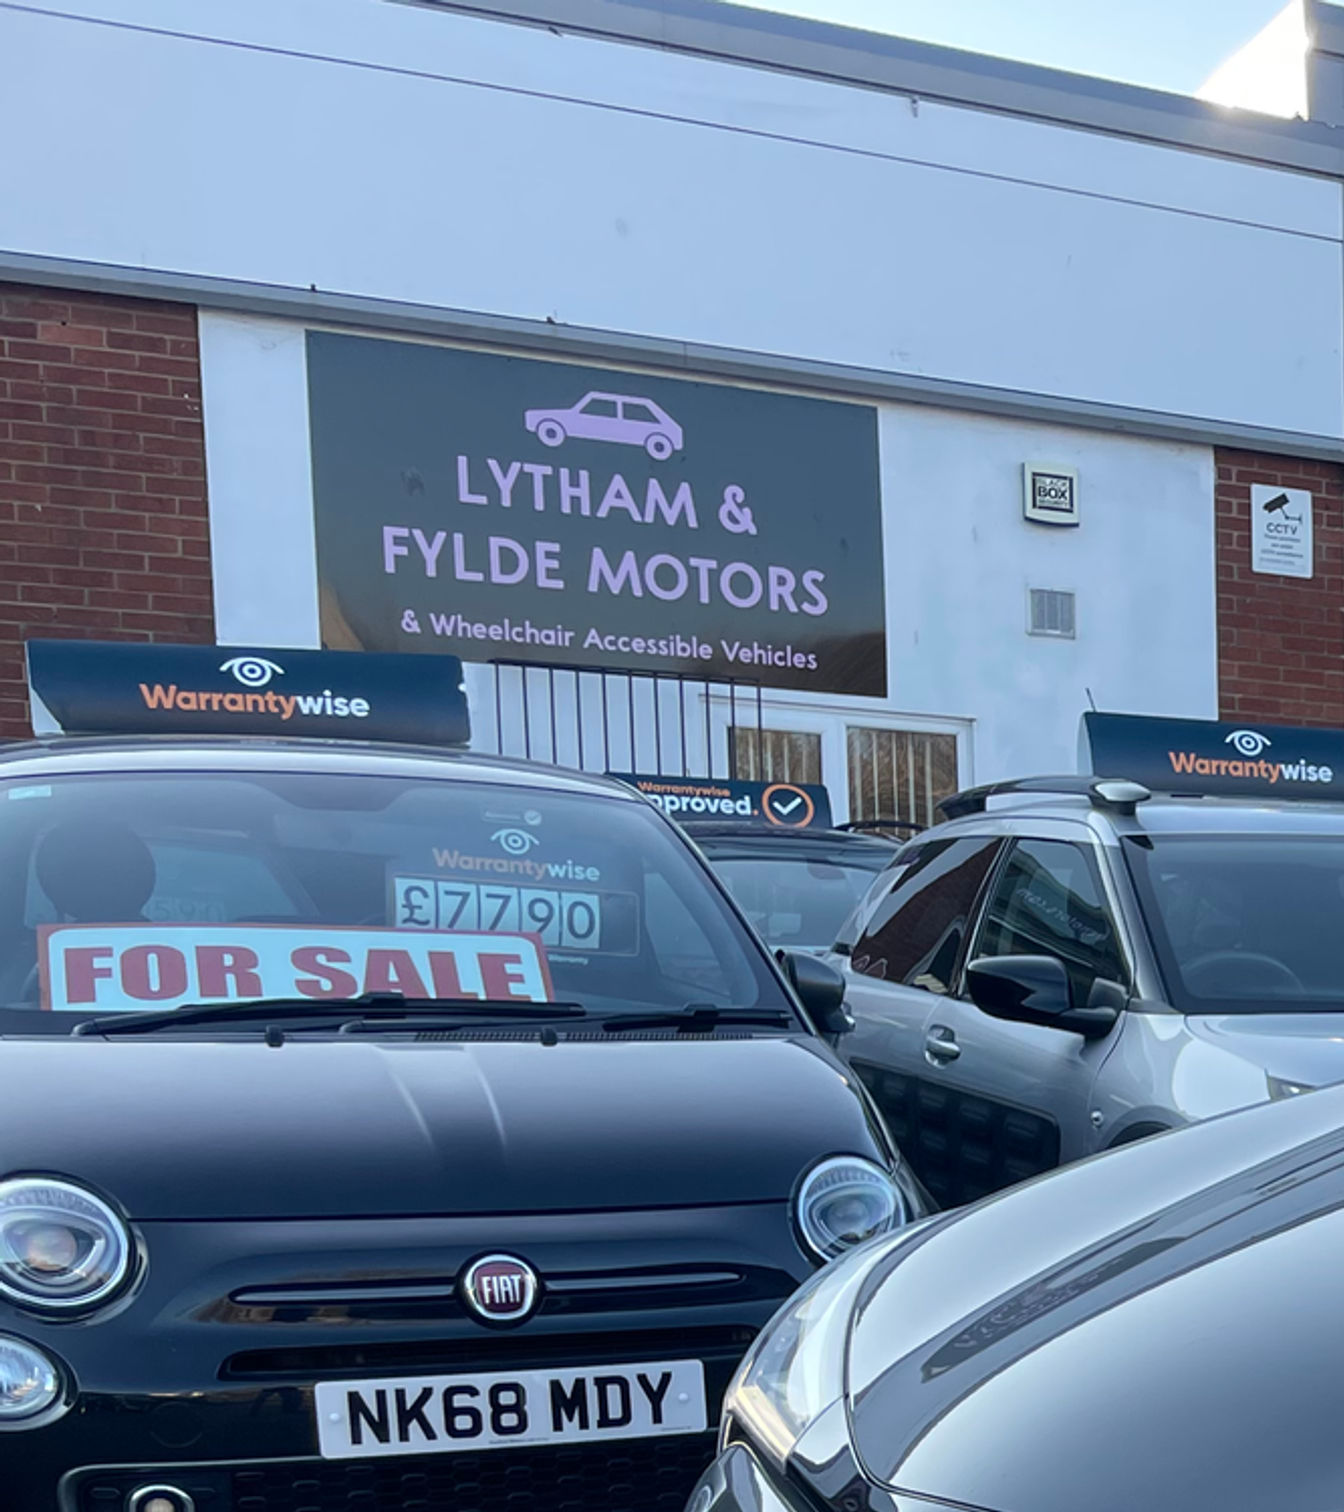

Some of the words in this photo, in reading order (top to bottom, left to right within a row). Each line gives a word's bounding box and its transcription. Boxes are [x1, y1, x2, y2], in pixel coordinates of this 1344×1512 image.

[456, 455, 699, 529] LYTHAM
[718, 484, 758, 536] &
[1037, 485, 1068, 500] BOX
[1266, 522, 1298, 535] CCTV
[382, 525, 564, 590] FYLDE
[587, 546, 829, 617] MOTORS
[400, 609, 422, 634] &
[429, 613, 576, 648] Wheelchair
[583, 627, 714, 660] Accessible
[721, 640, 818, 670] Vehicles
[138, 681, 371, 721] Warrantywise
[1168, 751, 1334, 784] Warrantywise
[637, 781, 731, 798] Warrantywise
[432, 846, 600, 883] Warrantywise
[401, 885, 597, 940] £7790
[63, 944, 263, 1004] FOR
[289, 946, 531, 1001] SALE
[480, 1273, 523, 1305] FIAT
[346, 1381, 529, 1446] NK68
[549, 1371, 673, 1433] MDY
